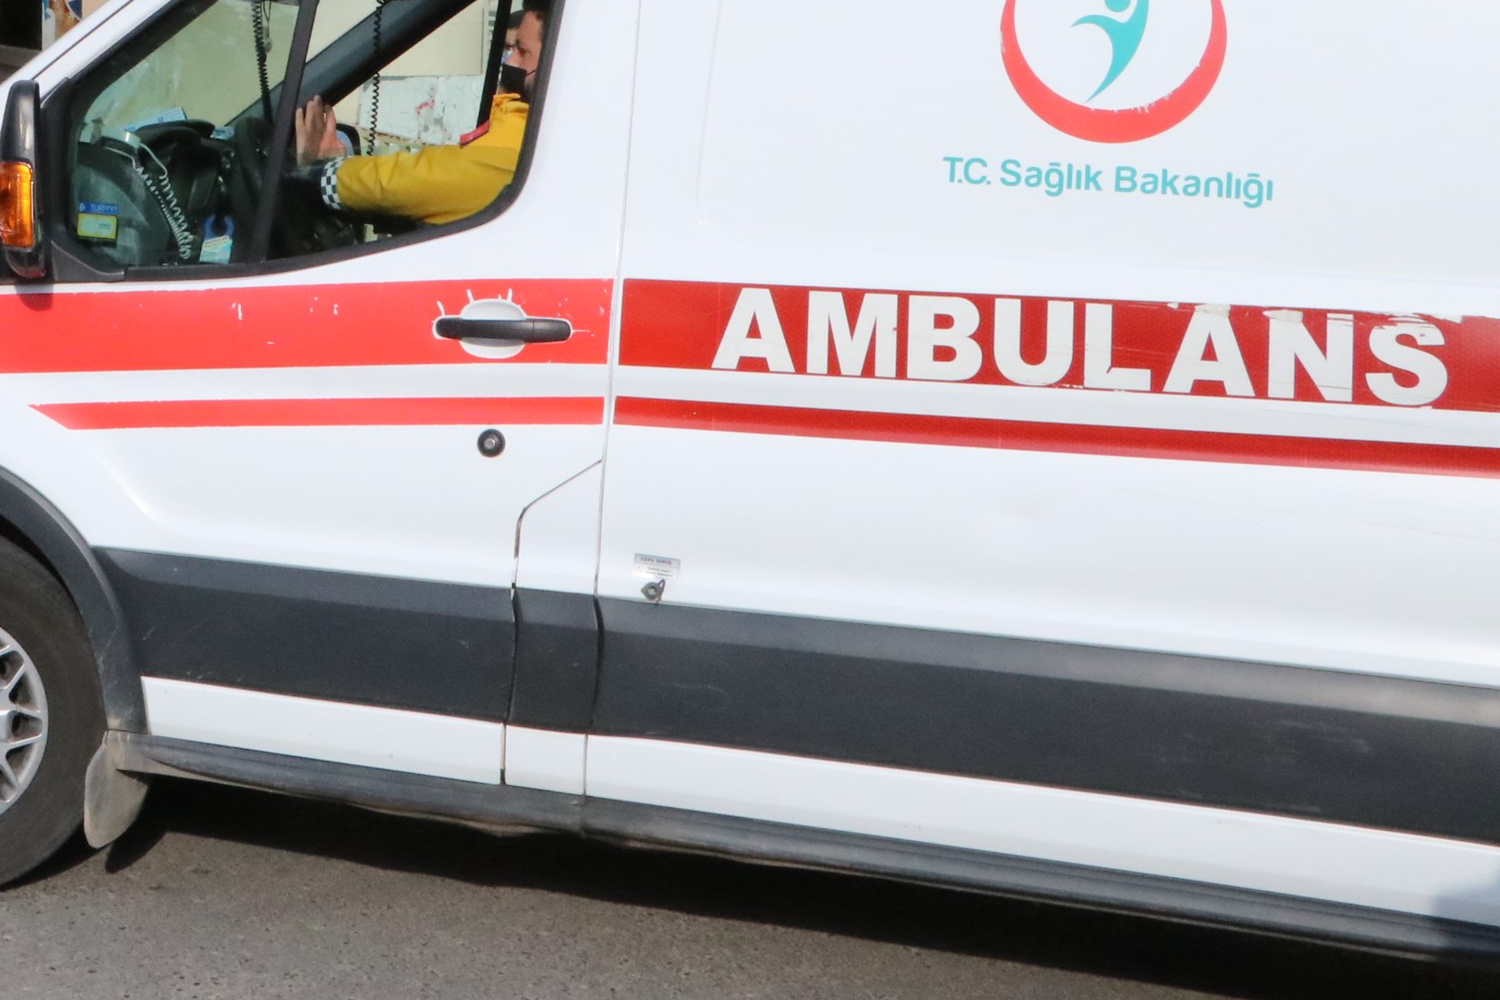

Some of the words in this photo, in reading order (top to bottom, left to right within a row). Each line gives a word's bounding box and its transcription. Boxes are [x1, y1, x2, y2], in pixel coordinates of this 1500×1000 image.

[942, 156, 992, 185] T.C.
[999, 158, 1103, 198] Sağlık
[1113, 165, 1274, 209] Bakanlığı
[711, 286, 1449, 407] AMBULANS
